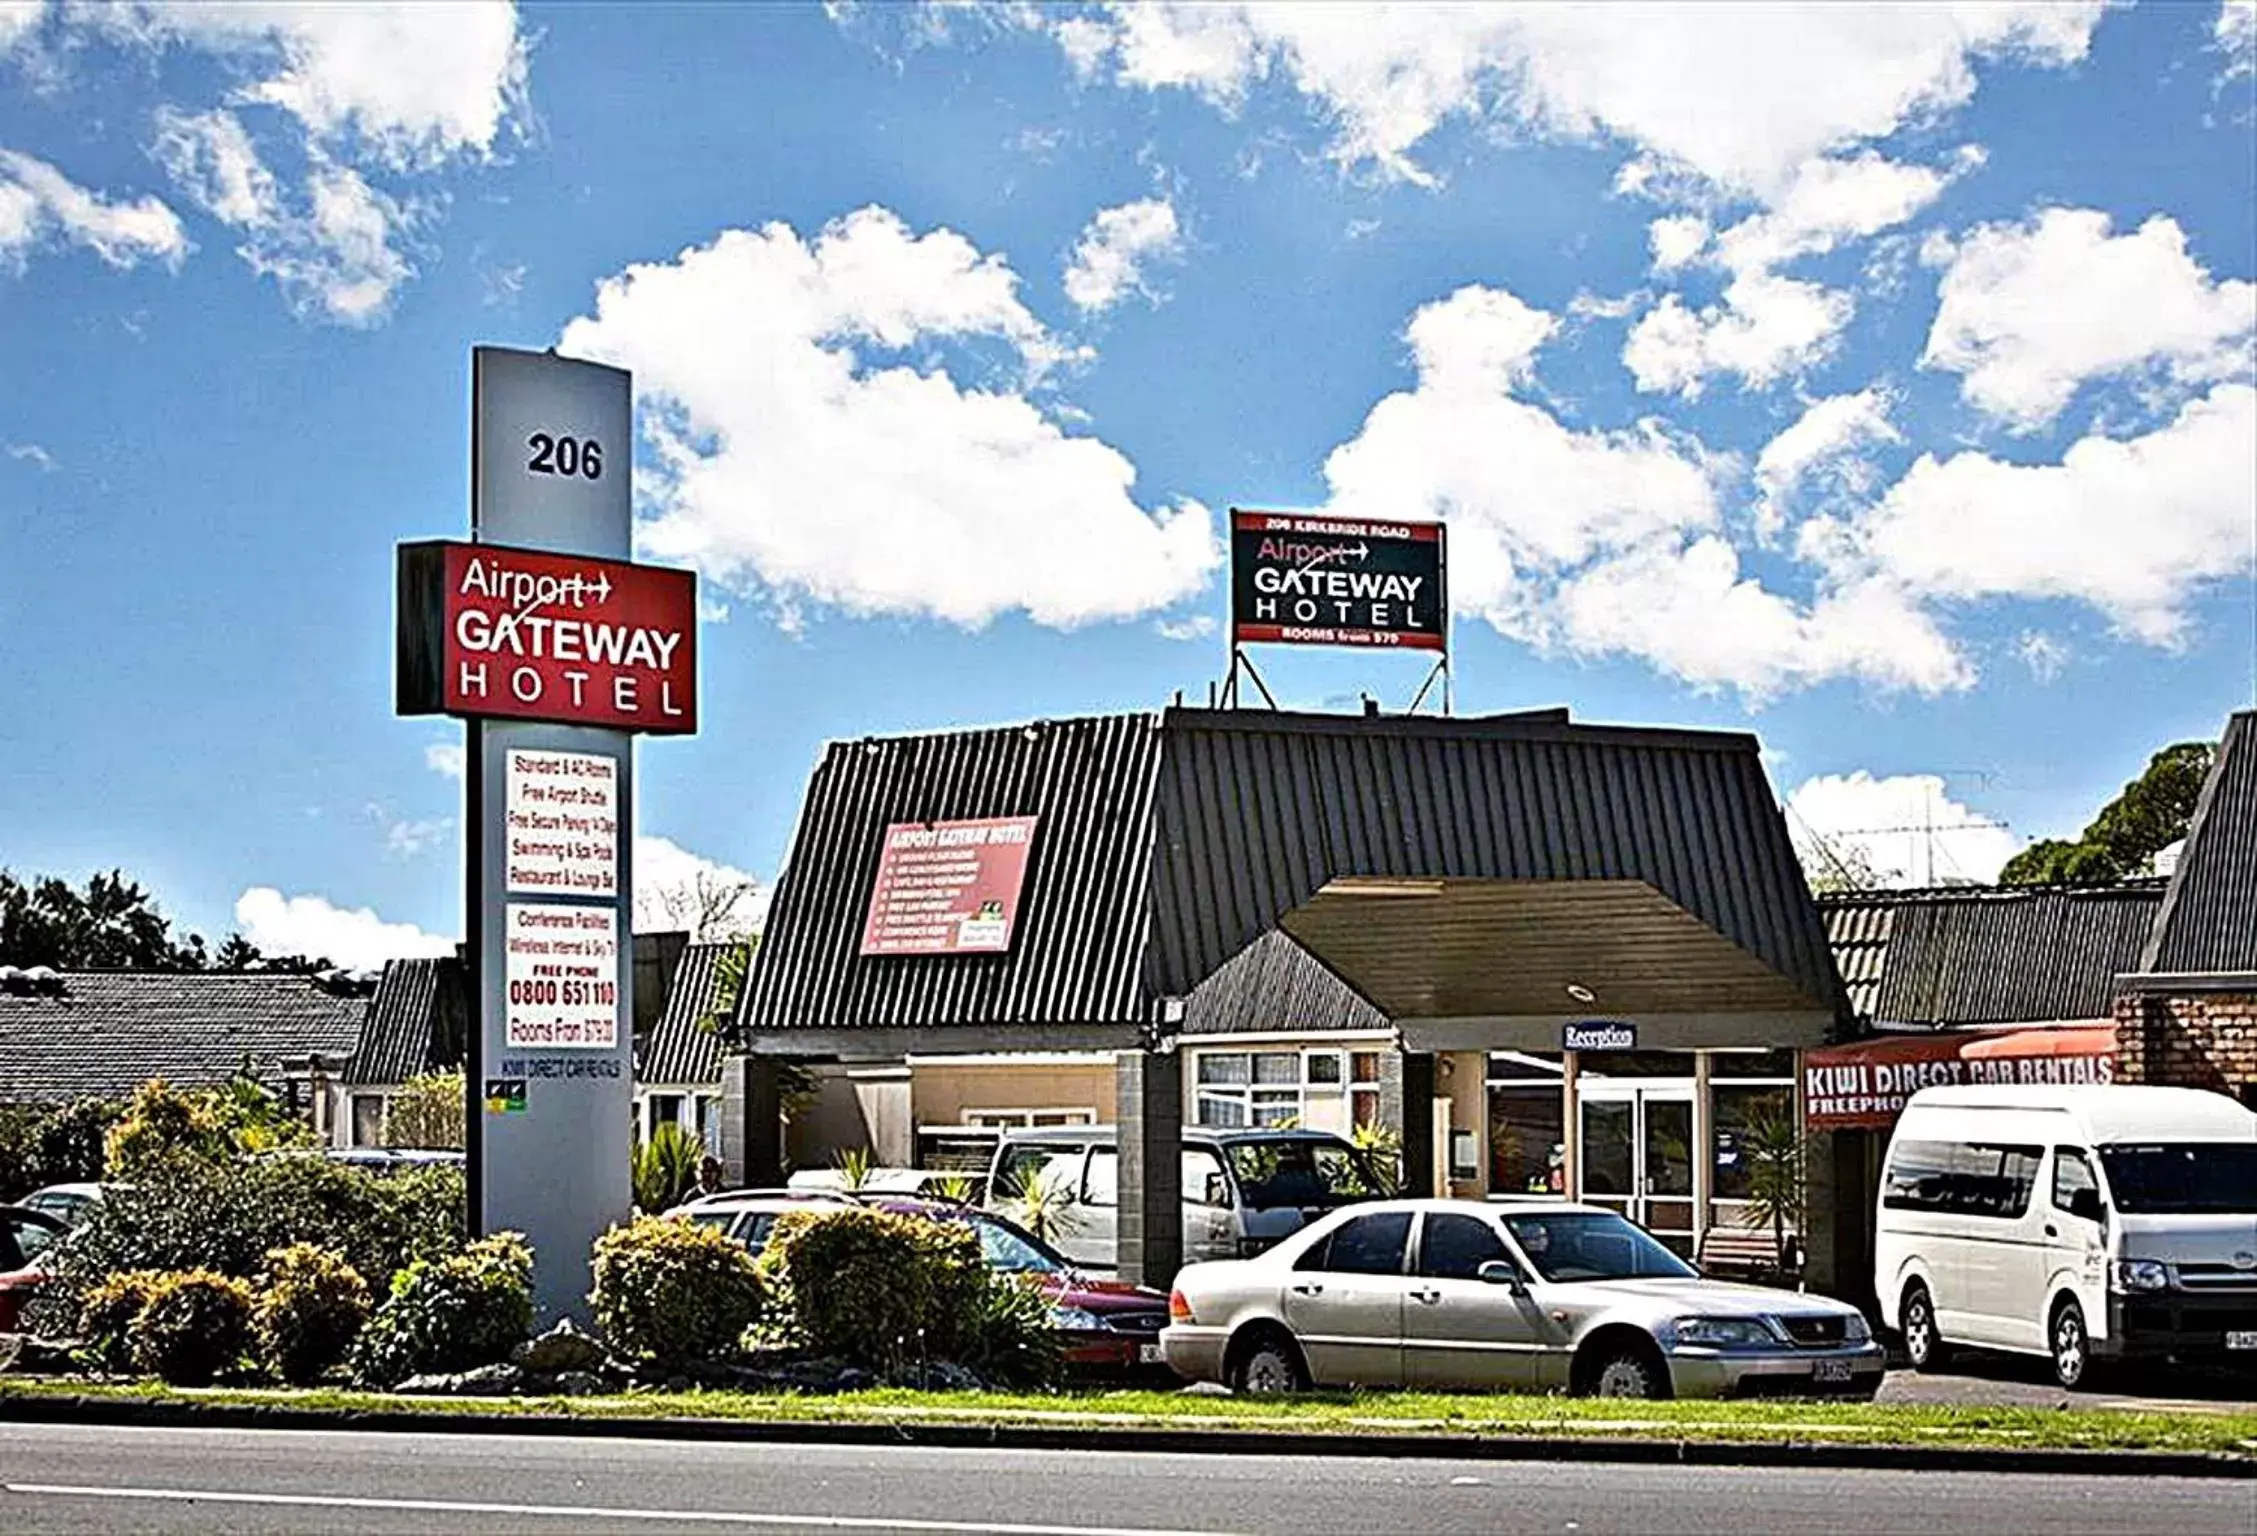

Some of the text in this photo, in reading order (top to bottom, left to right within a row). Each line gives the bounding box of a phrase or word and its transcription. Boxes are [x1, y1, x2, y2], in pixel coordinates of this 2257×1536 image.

[528, 432, 602, 480] 206
[1370, 525, 1410, 540] ROAD
[1256, 537, 1347, 566] Airport
[460, 557, 585, 608] Airport
[1254, 566, 1423, 602] GATEWAY
[1256, 597, 1422, 627] HOTEL
[456, 609, 681, 670] GATEWAY
[1282, 627, 1334, 641] ROOMS
[1338, 628, 1370, 642] from
[459, 661, 682, 715] HOTEL
[533, 963, 599, 978] FREE PHONE
[511, 979, 557, 1006] 0800
[562, 980, 590, 1006] 651
[511, 1017, 553, 1042] Rooms
[1566, 1024, 1633, 1049] Reception
[1806, 1056, 2114, 1097] KIWI DIRECT CAR RENTALS
[1808, 1095, 1904, 1115] FREEPHO
